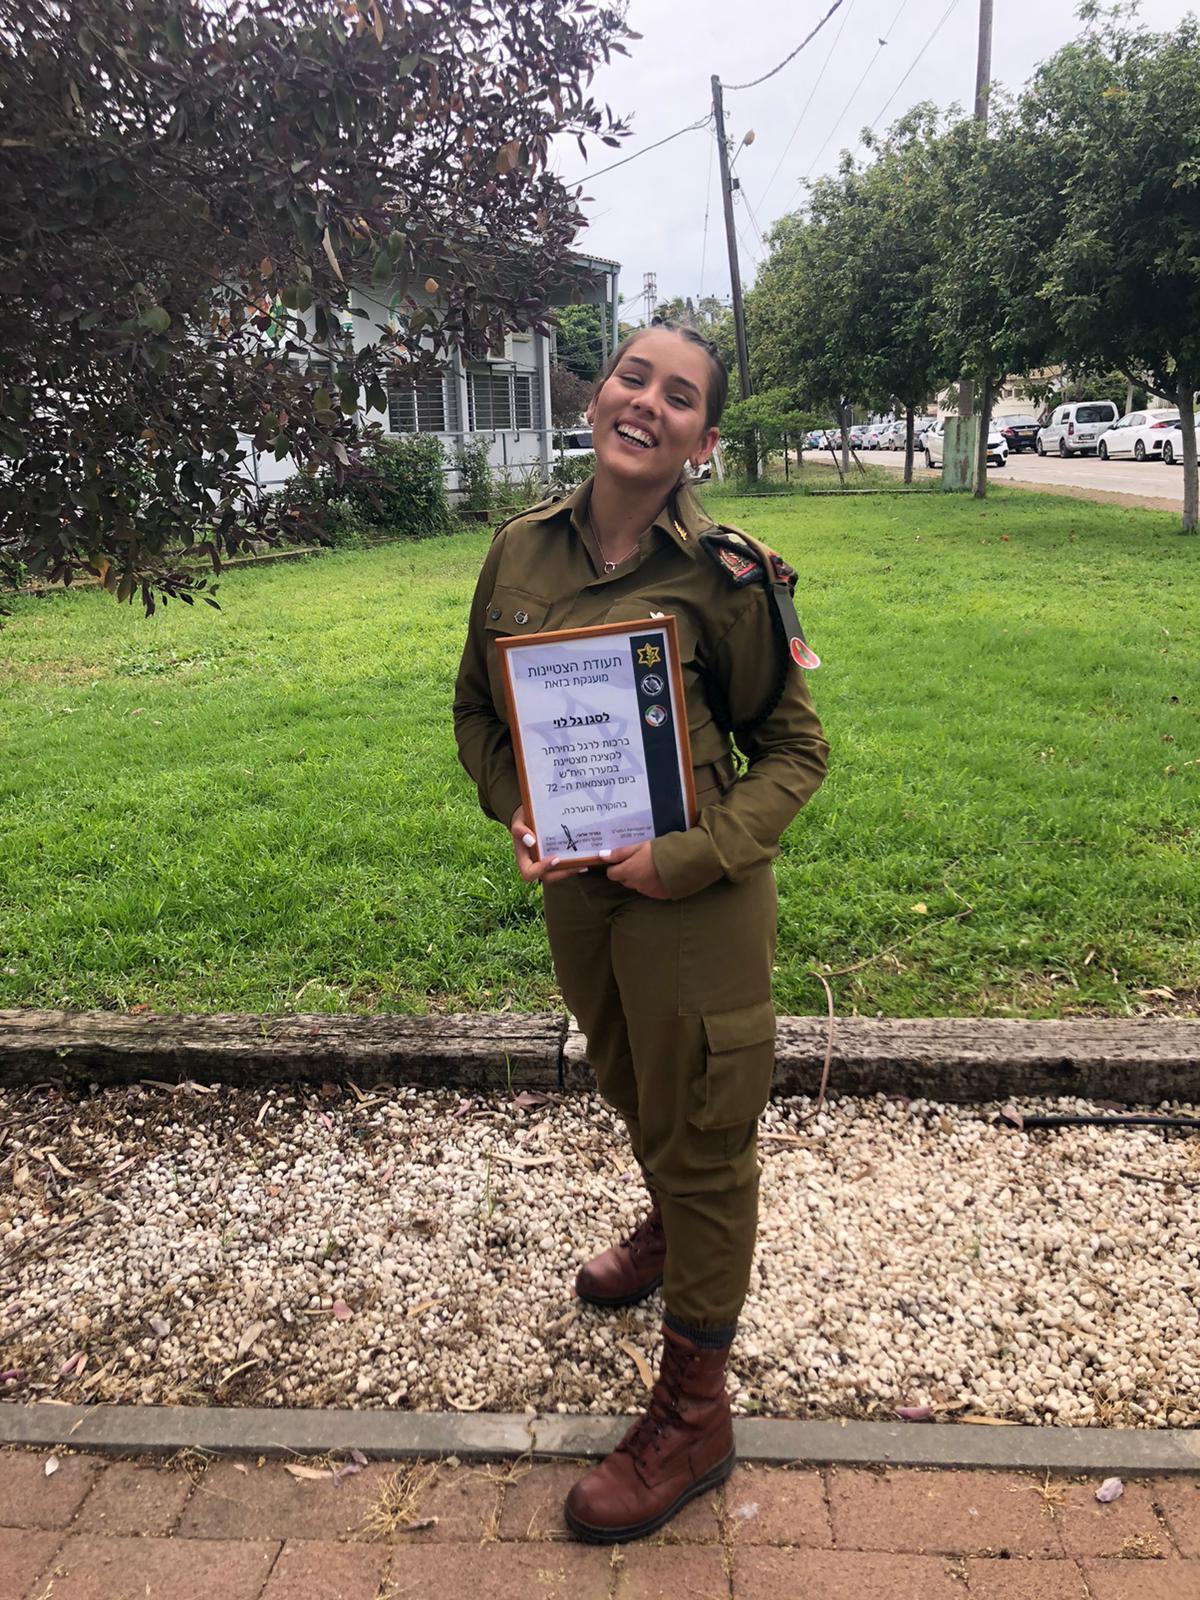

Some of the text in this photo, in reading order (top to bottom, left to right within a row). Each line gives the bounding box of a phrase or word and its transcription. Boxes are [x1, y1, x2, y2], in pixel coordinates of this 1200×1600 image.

[528, 656, 622, 678] תעודת הצטיינות
[544, 673, 609, 689] מוענקת בזאת
[553, 712, 610, 728] לסגן גל לוי
[541, 737, 630, 756] ברכות לרגל בחירתך
[553, 750, 622, 767] לקצינה מצטיינת
[588, 764, 620, 776] במערך
[575, 777, 616, 790] העצמאות
[618, 775, 636, 785] ביום
[546, 783, 558, 792] 72
[596, 801, 628, 811] בהוקרה
